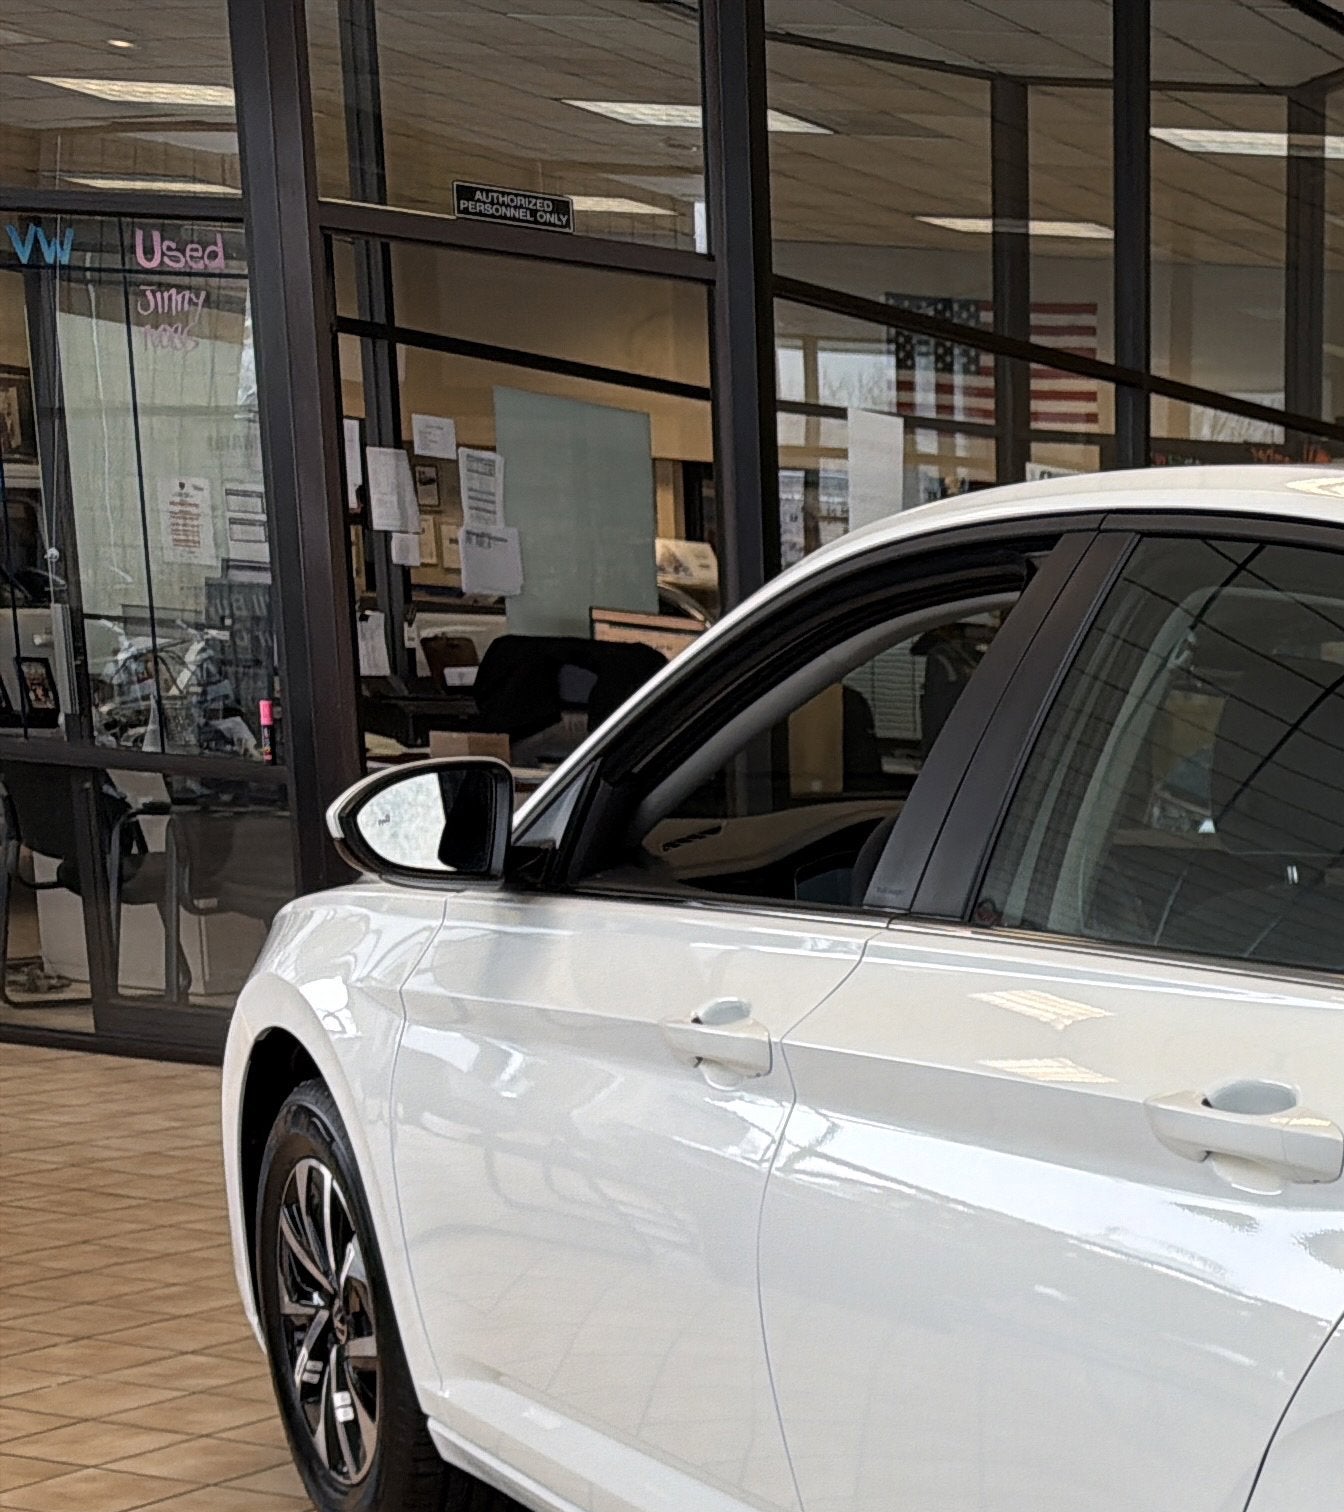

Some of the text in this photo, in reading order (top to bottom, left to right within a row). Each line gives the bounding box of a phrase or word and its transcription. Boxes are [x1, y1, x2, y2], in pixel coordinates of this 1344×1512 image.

[460, 199, 568, 226] PERSONNEL ONLY
[474, 190, 553, 212] AUTHORIZED
[6, 223, 75, 265] VW
[135, 227, 225, 270] Used
